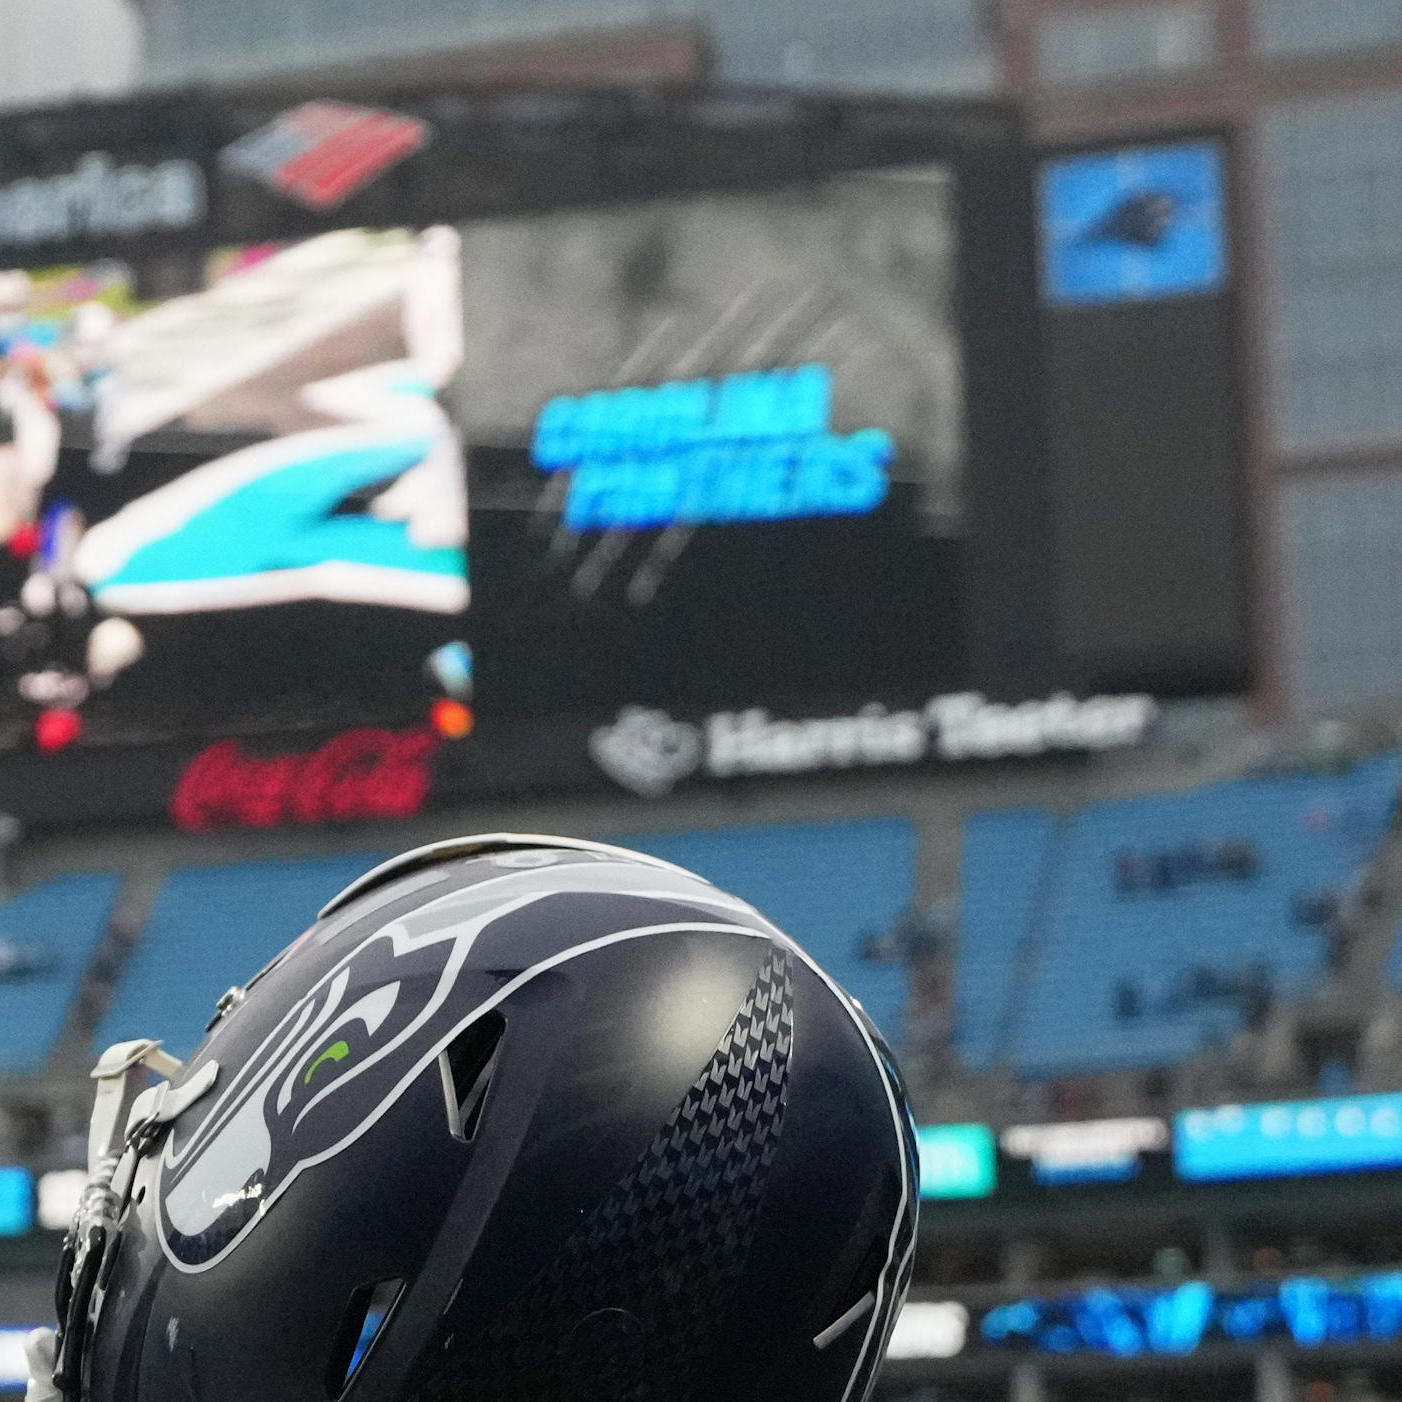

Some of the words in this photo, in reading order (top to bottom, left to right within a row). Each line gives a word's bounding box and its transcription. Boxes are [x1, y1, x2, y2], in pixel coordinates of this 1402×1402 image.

[173, 728, 433, 830] Coca-Cola
[708, 707, 923, 777] Harris
[928, 691, 1157, 760] Teeter
